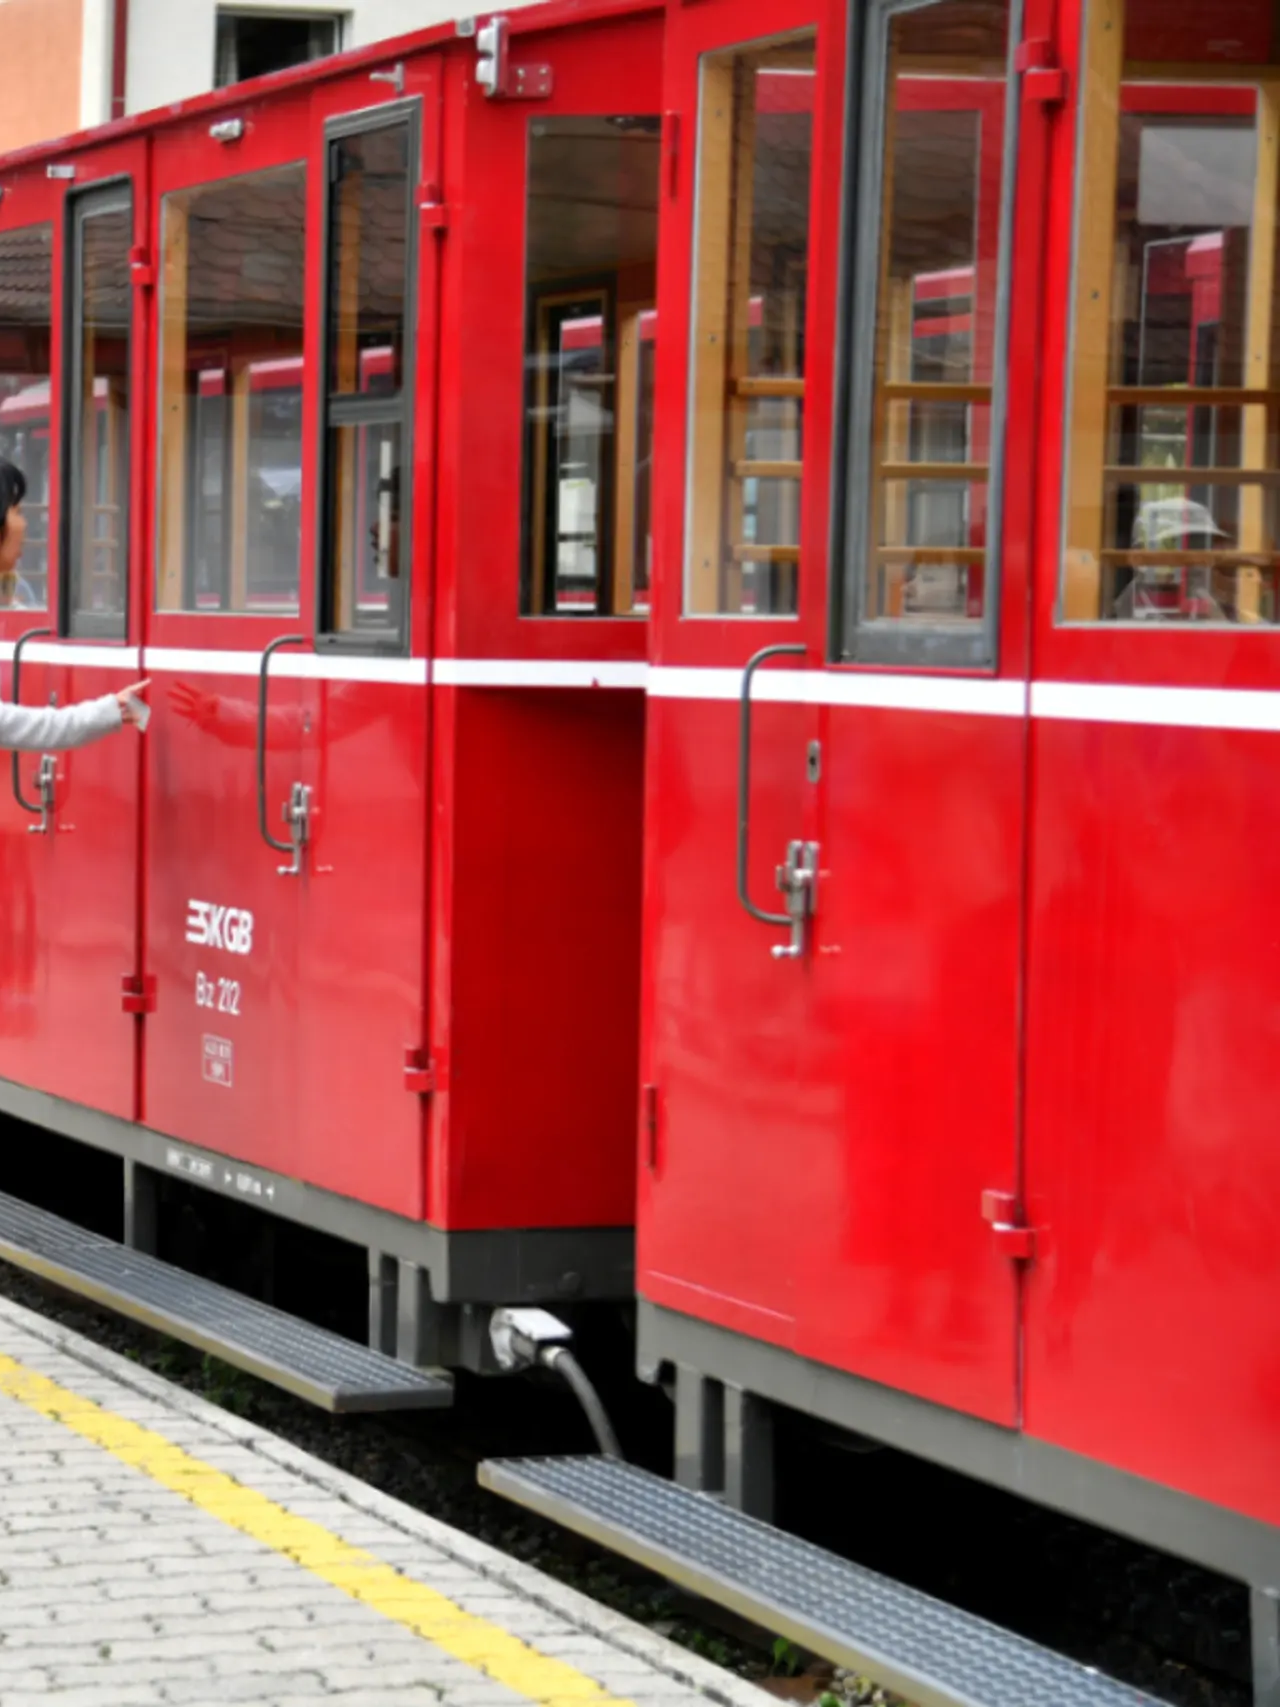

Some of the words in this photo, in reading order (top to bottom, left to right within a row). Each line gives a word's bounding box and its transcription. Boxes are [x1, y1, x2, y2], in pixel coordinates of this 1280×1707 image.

[185, 898, 254, 954] SKGB
[196, 971, 215, 1008] Bz
[218, 977, 241, 1015] 212
